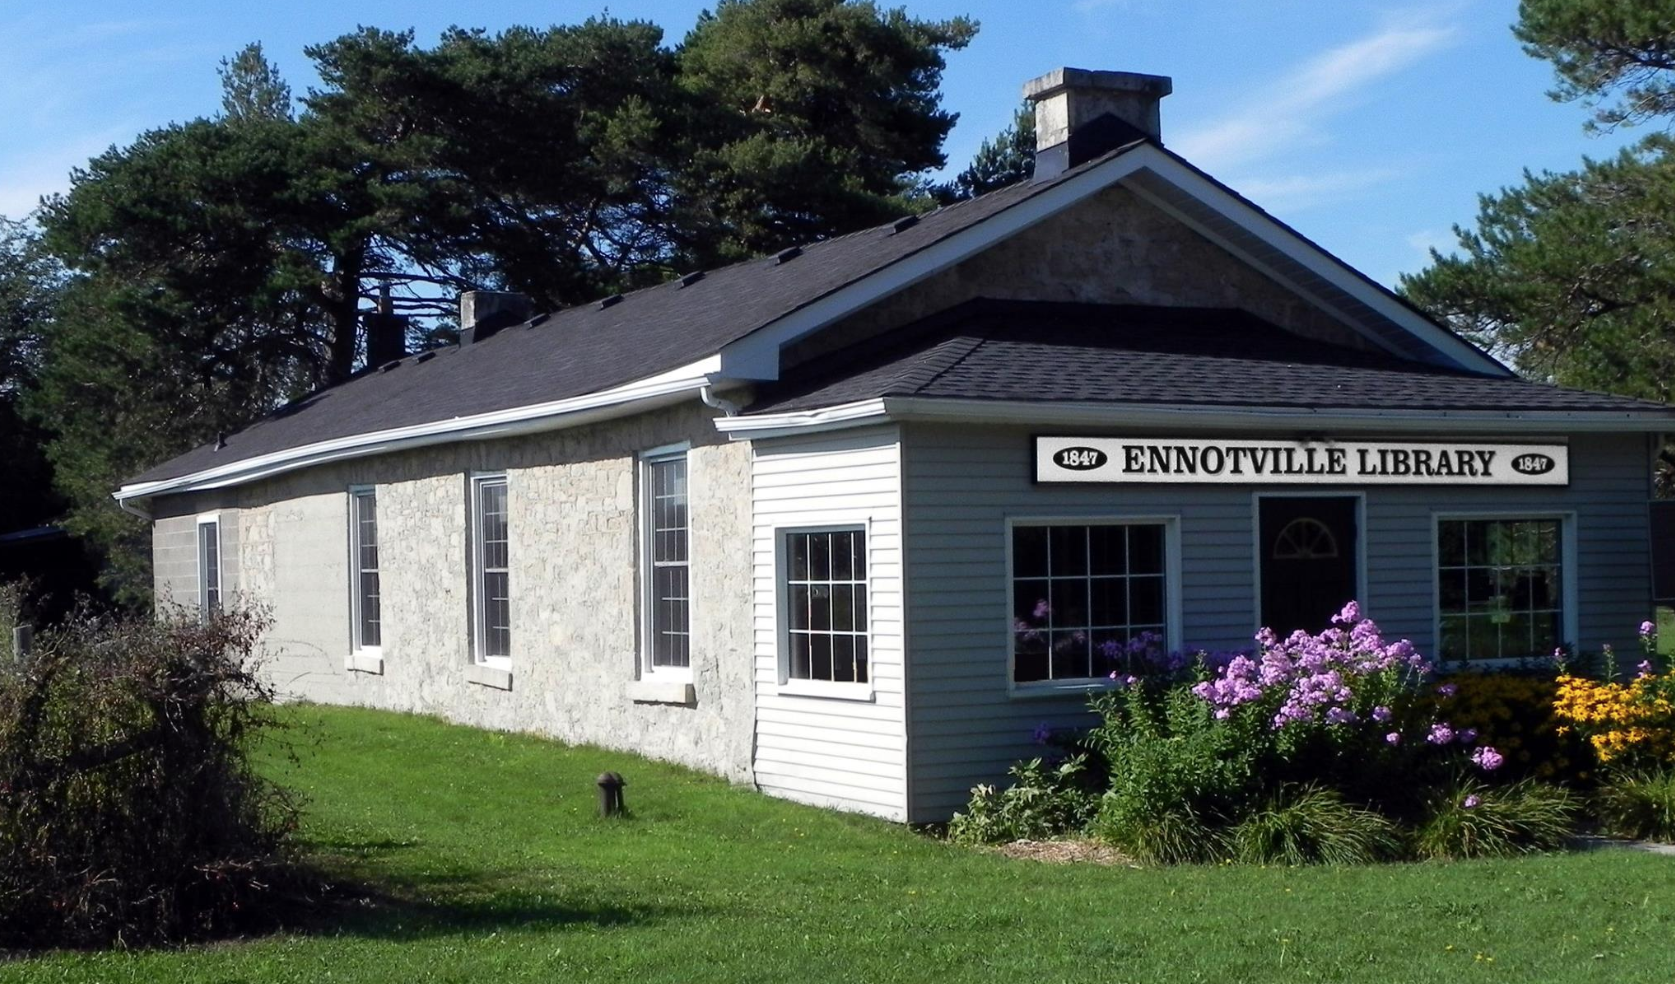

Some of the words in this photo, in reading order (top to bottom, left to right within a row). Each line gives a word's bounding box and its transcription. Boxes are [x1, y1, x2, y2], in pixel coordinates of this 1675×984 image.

[1061, 450, 1098, 466] 1847
[1122, 445, 1346, 475] ENNOTVILLE
[1356, 448, 1496, 477] LIBRARY
[1517, 456, 1548, 471] 1847
